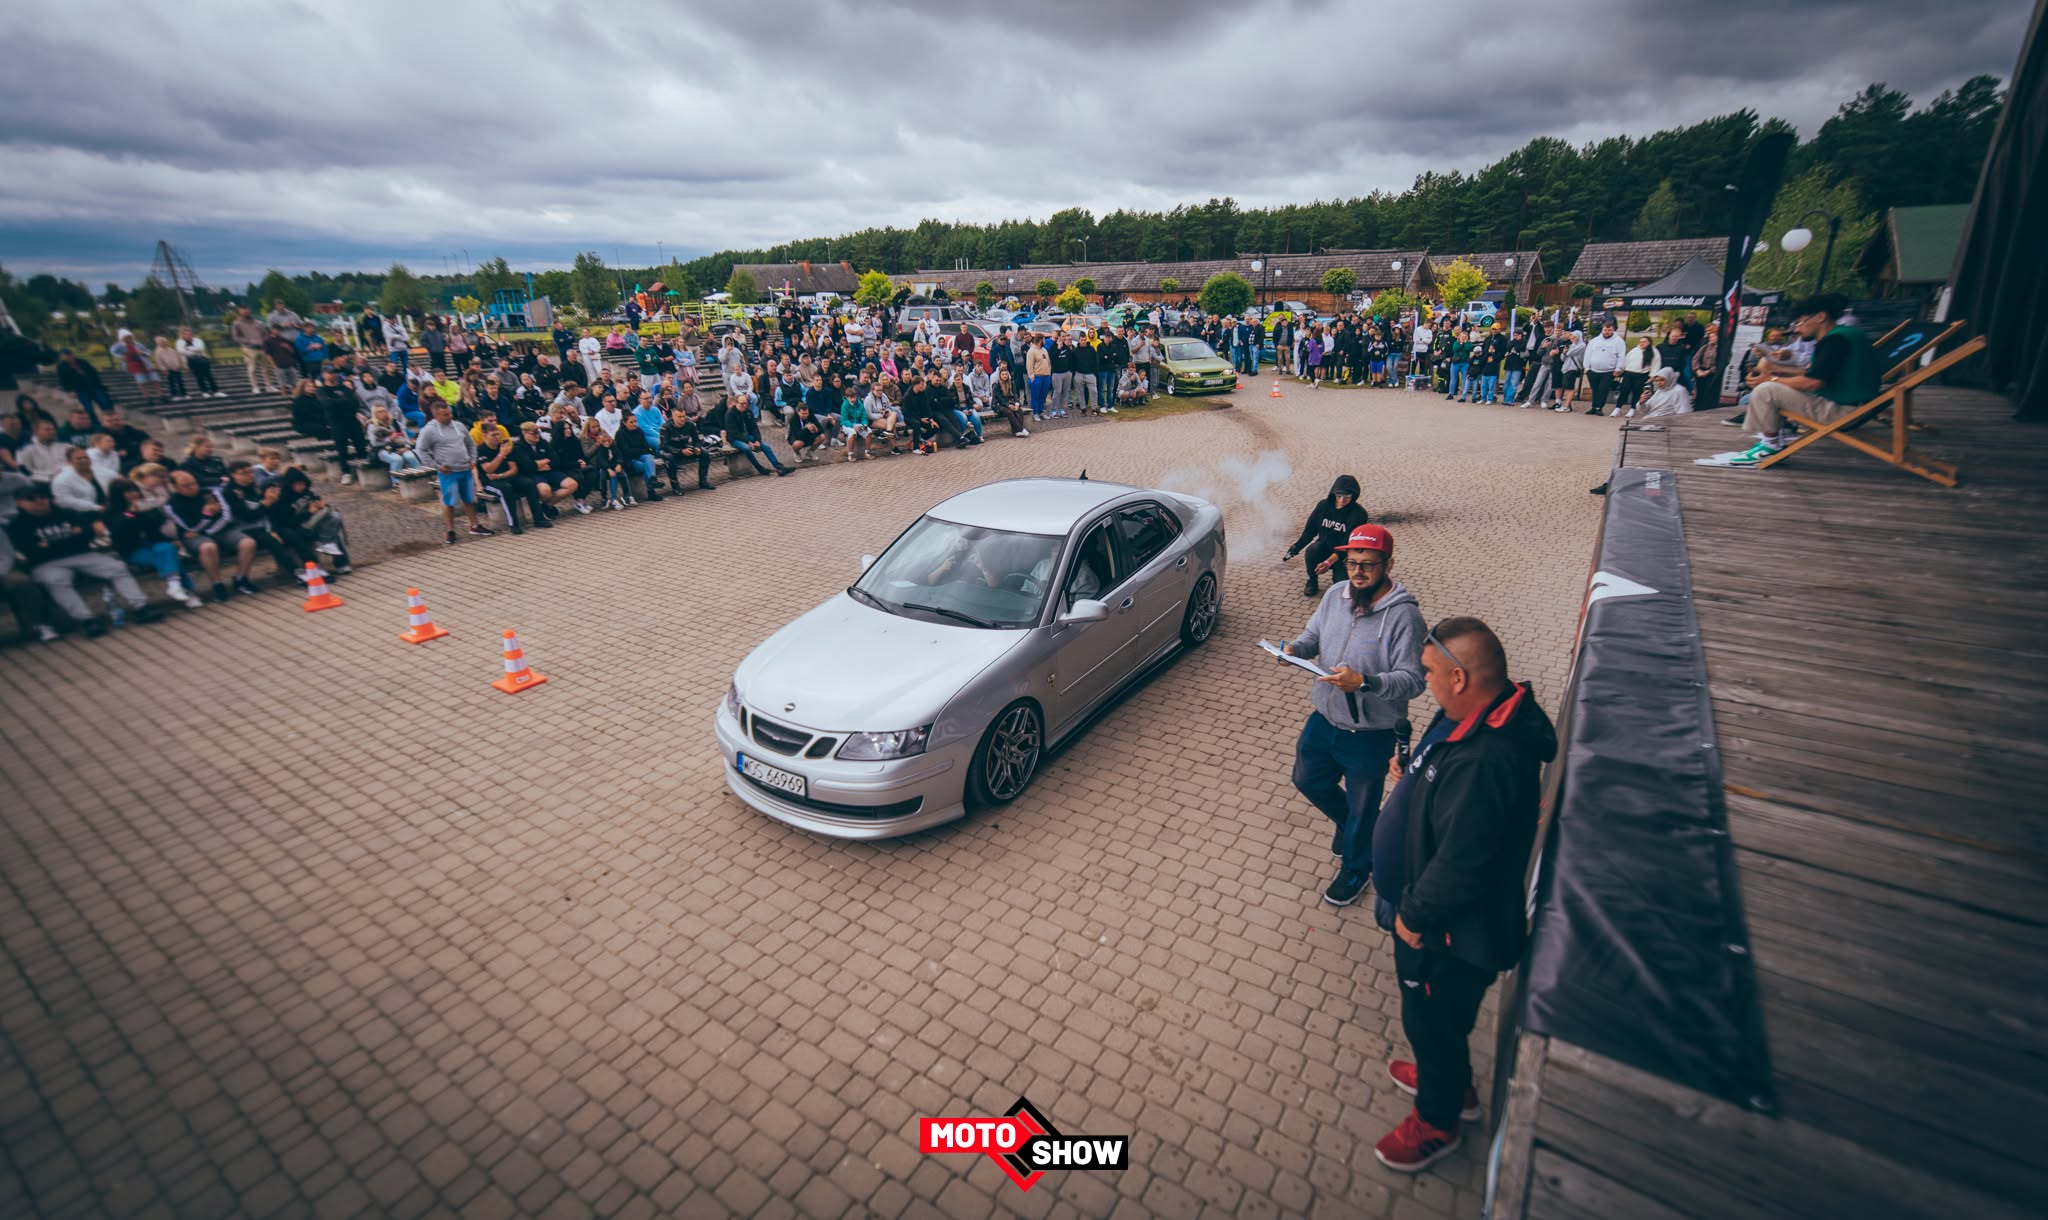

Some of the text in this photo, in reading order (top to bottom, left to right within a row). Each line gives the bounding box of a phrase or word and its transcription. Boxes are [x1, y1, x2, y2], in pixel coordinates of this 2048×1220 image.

[1631, 296, 1705, 307] www.serwishub.pl
[1321, 518, 1347, 533] NASA
[766, 769, 803, 793] 66969
